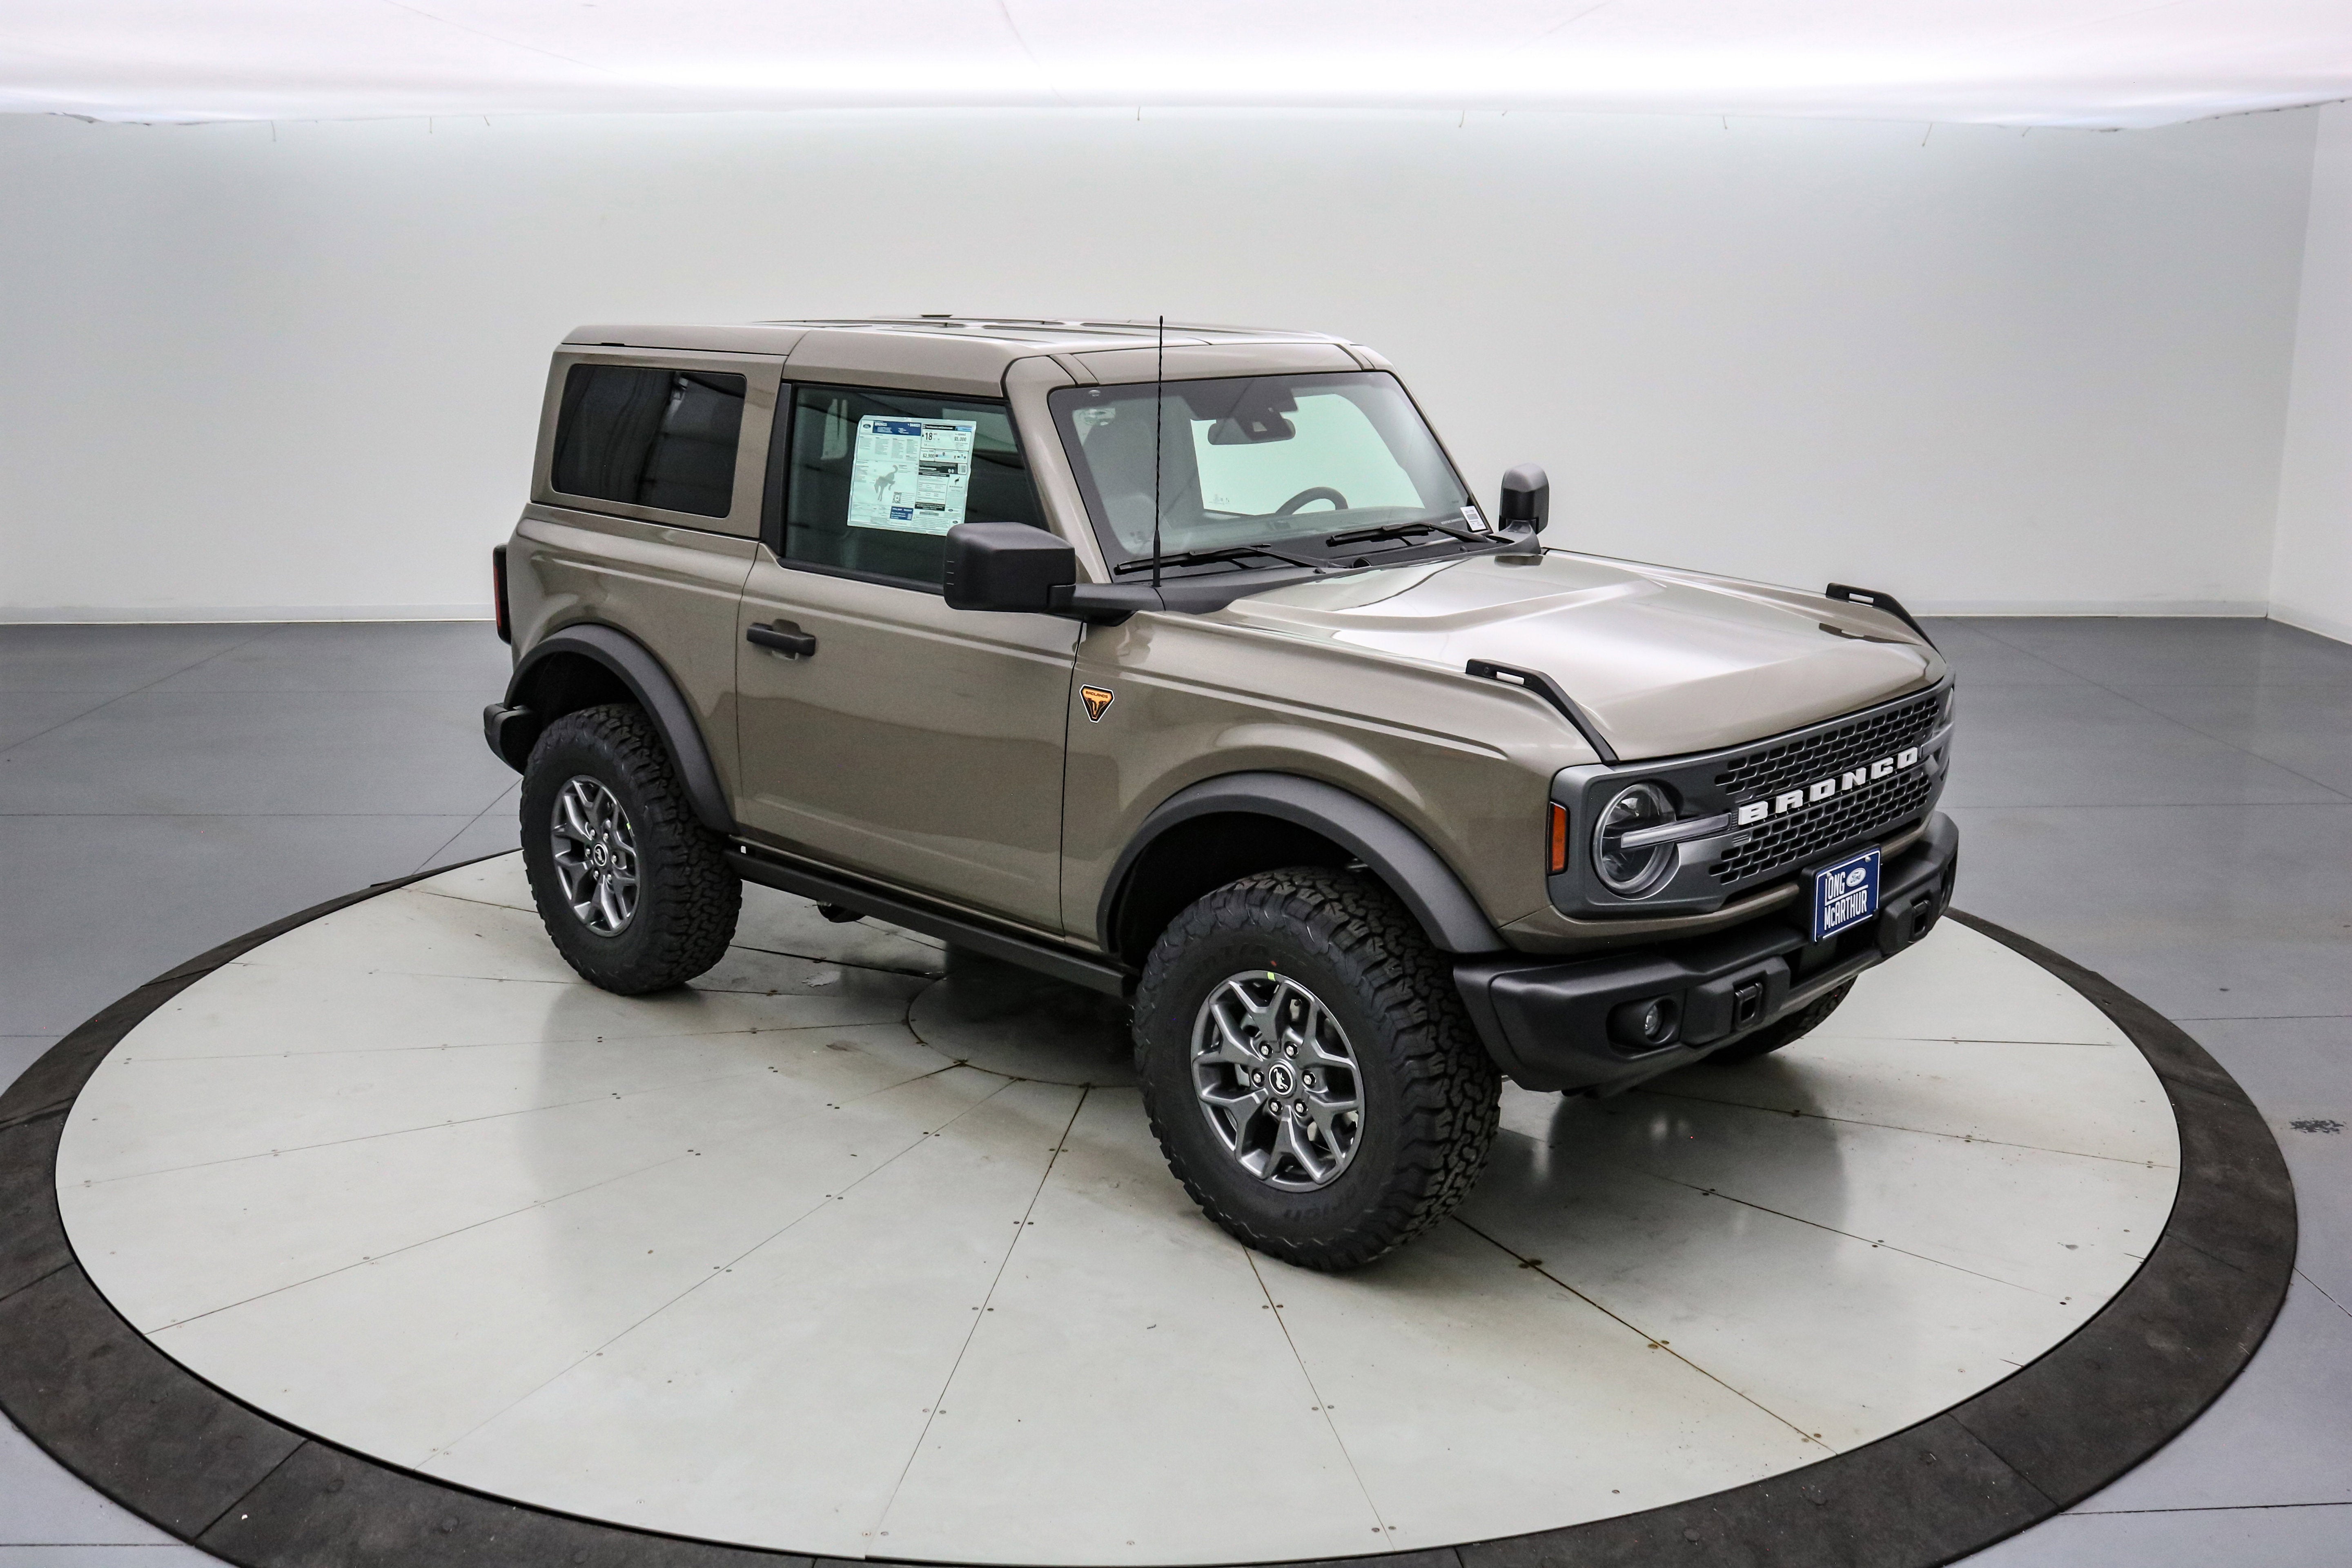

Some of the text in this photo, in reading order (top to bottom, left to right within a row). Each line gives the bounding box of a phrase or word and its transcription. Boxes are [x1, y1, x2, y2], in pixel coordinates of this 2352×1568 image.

[1738, 747, 1918, 825] BRONCO
[1825, 871, 1846, 903] LONG
[1824, 890, 1867, 931] McARTHUR
